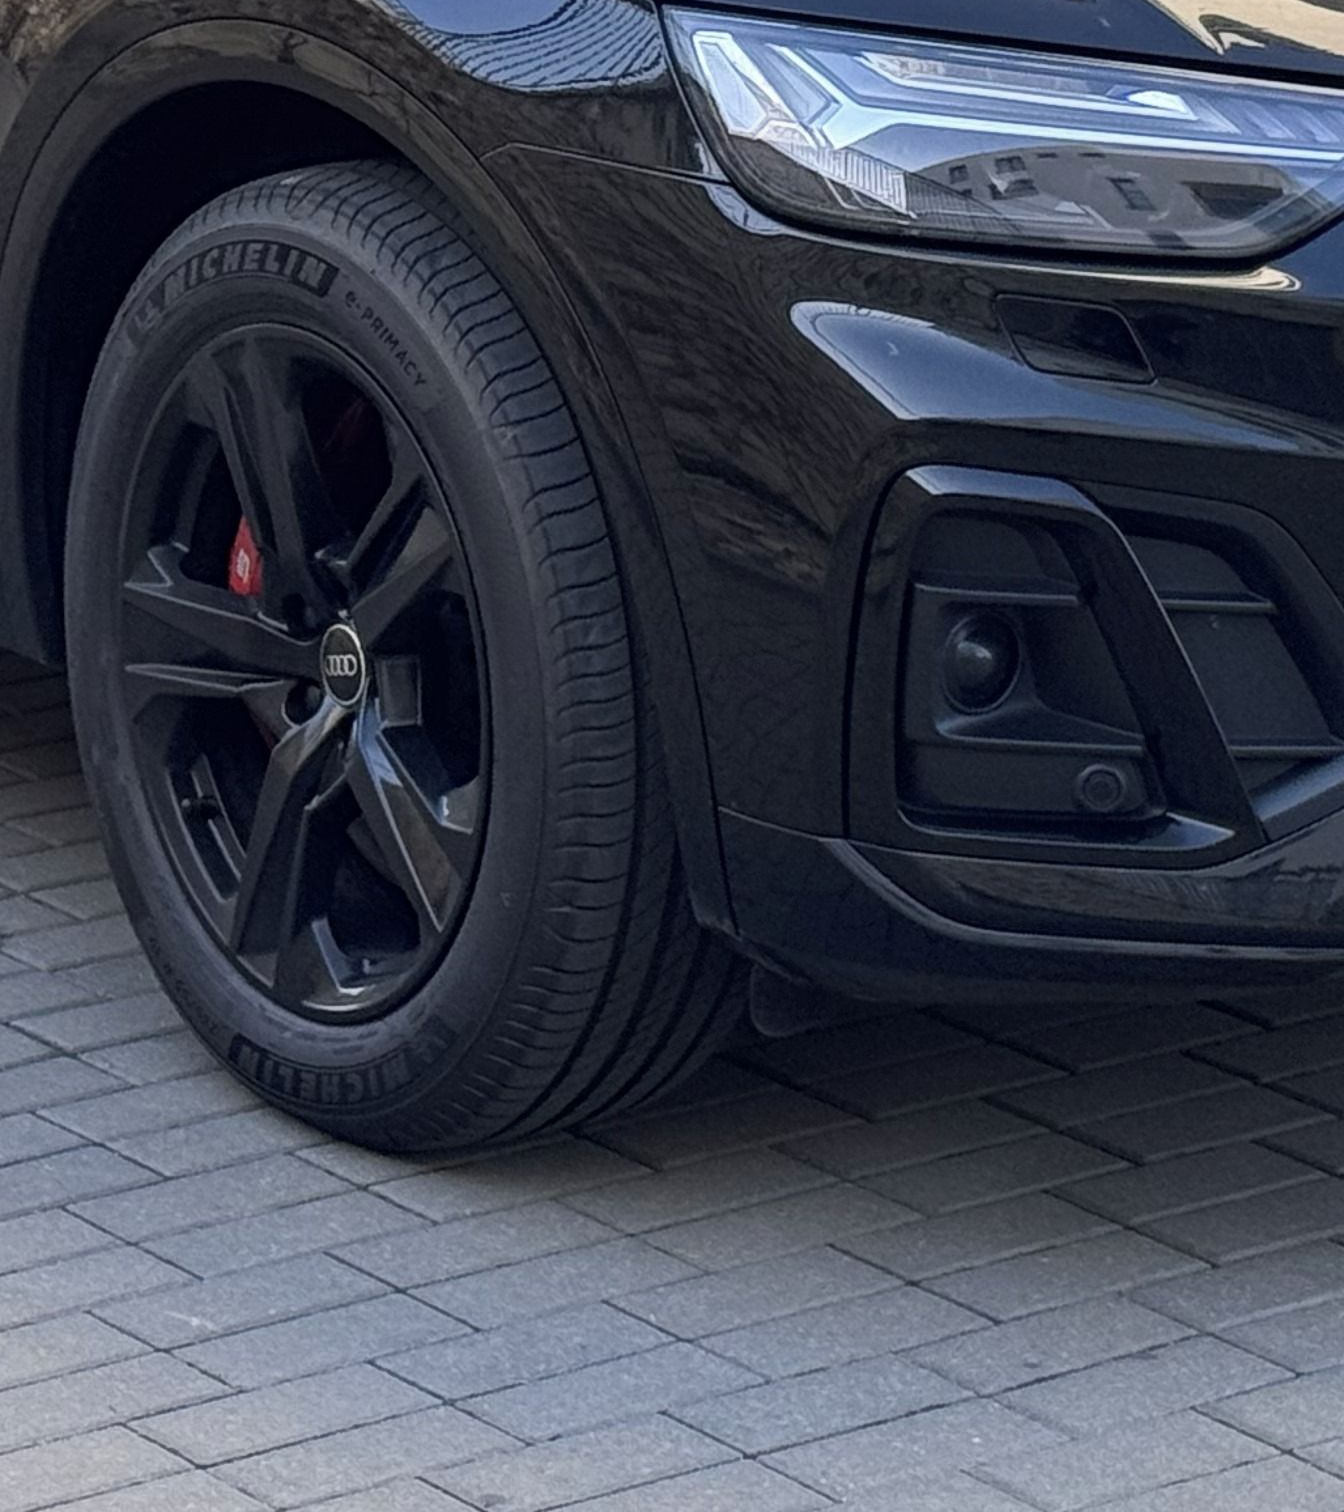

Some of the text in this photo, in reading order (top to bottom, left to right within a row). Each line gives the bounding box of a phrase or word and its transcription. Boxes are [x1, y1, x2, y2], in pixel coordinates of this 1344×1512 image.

[163, 242, 428, 387] MICHELIN e-PRIMACY
[235, 1044, 408, 1105] MICHELIN
